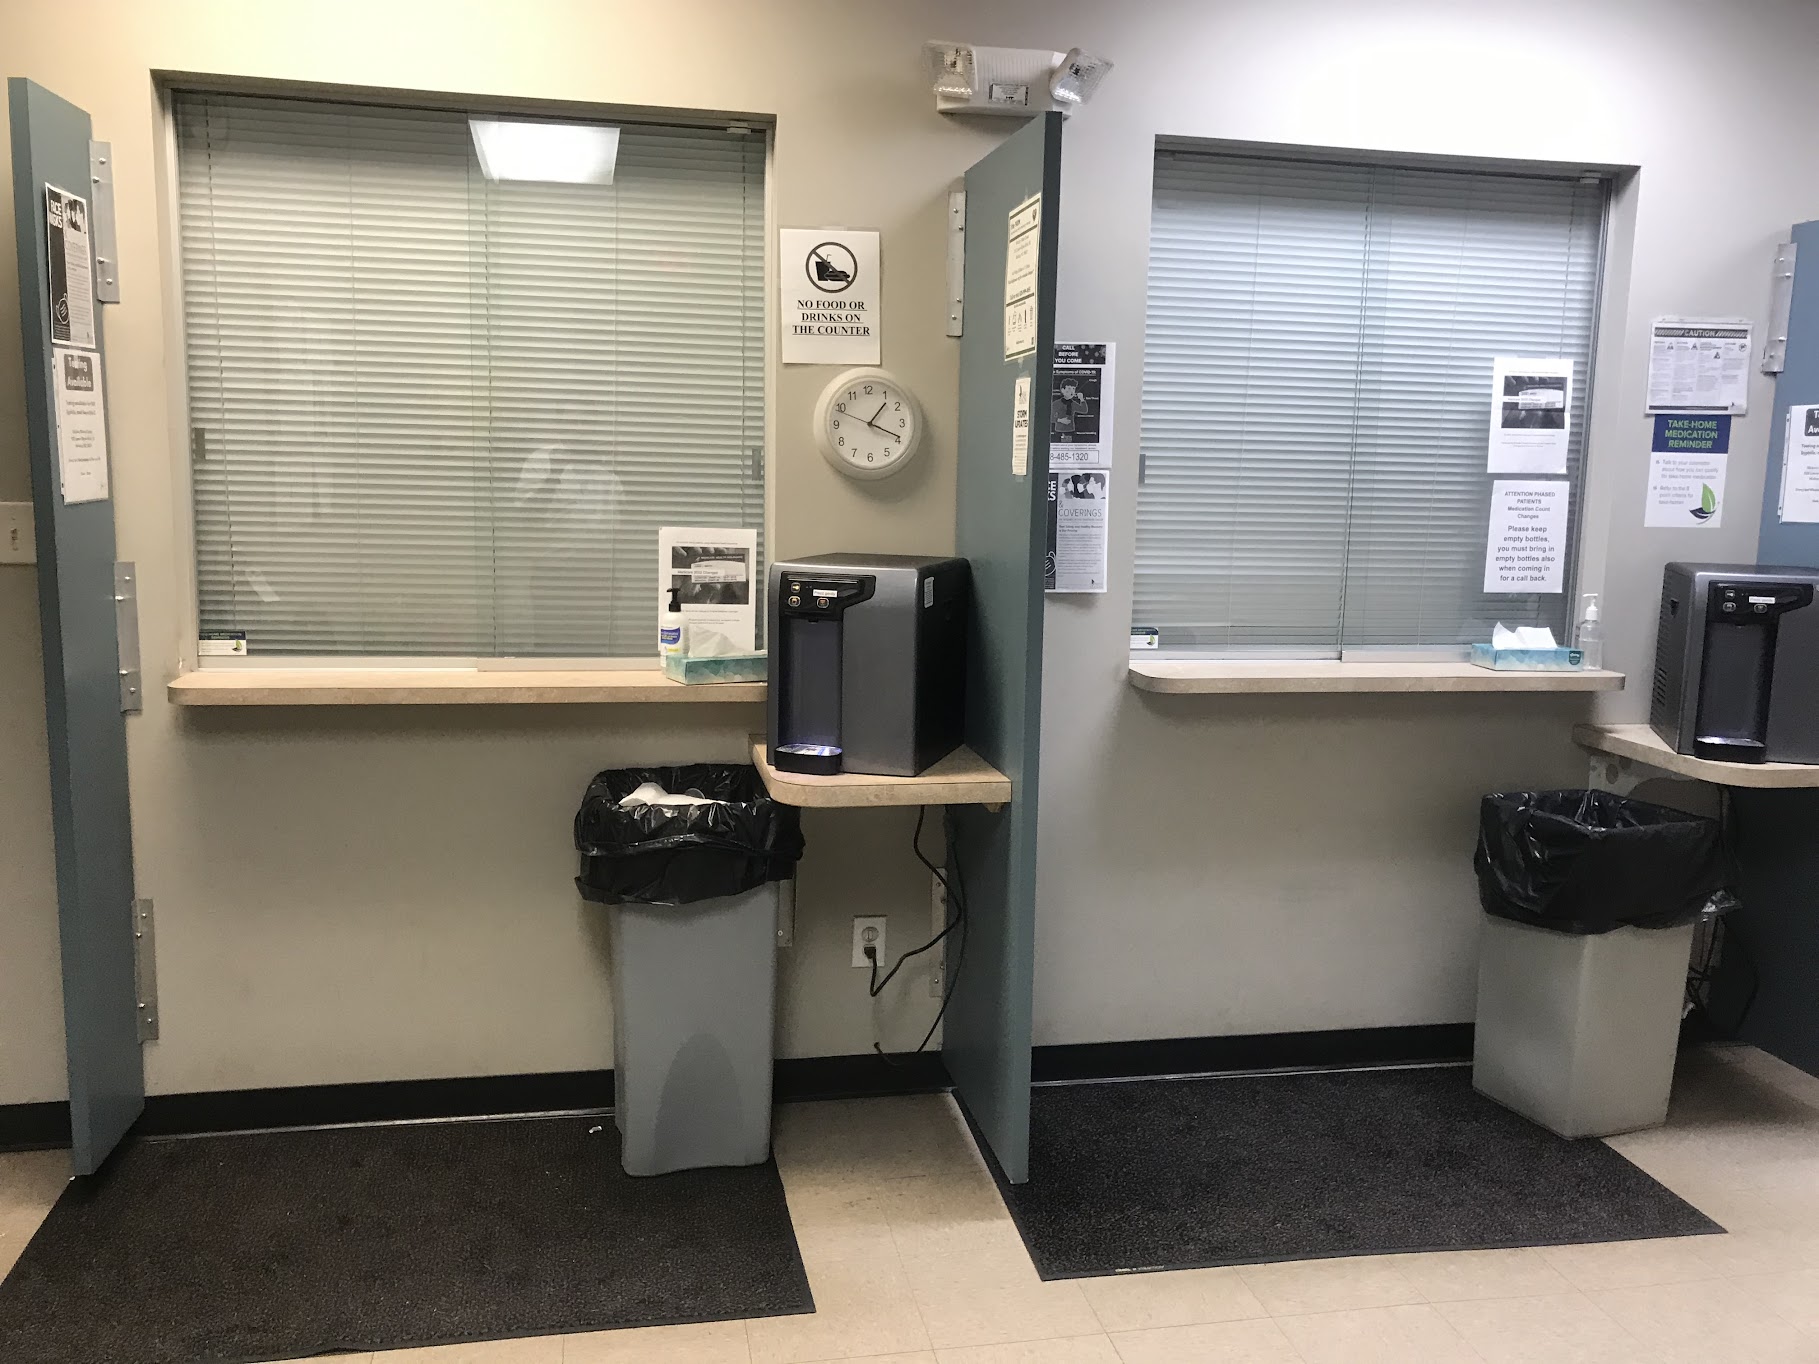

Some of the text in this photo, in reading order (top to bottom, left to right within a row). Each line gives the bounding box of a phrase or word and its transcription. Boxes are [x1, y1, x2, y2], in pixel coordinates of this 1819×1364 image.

[797, 299, 865, 310] NO FOOD OR
[801, 312, 861, 322] DRINKS ON
[792, 325, 870, 335] THE COUNTER
[863, 385, 873, 395] 12
[882, 390, 887, 400] 1
[848, 391, 857, 401] 11
[836, 402, 846, 413] 10
[894, 401, 901, 412] 2
[833, 420, 840, 430] 9
[899, 418, 906, 428] 3
[1667, 419, 1717, 429] TAKE-HOME
[1665, 429, 1718, 439] MEDICATION
[838, 436, 845, 447] 8
[894, 434, 901, 445] 4
[1668, 439, 1713, 449] REMINDER
[851, 448, 858, 458] 7
[883, 447, 890, 457] 5
[867, 452, 874, 463] 6
[1058, 508, 1102, 517] COVERINGS
